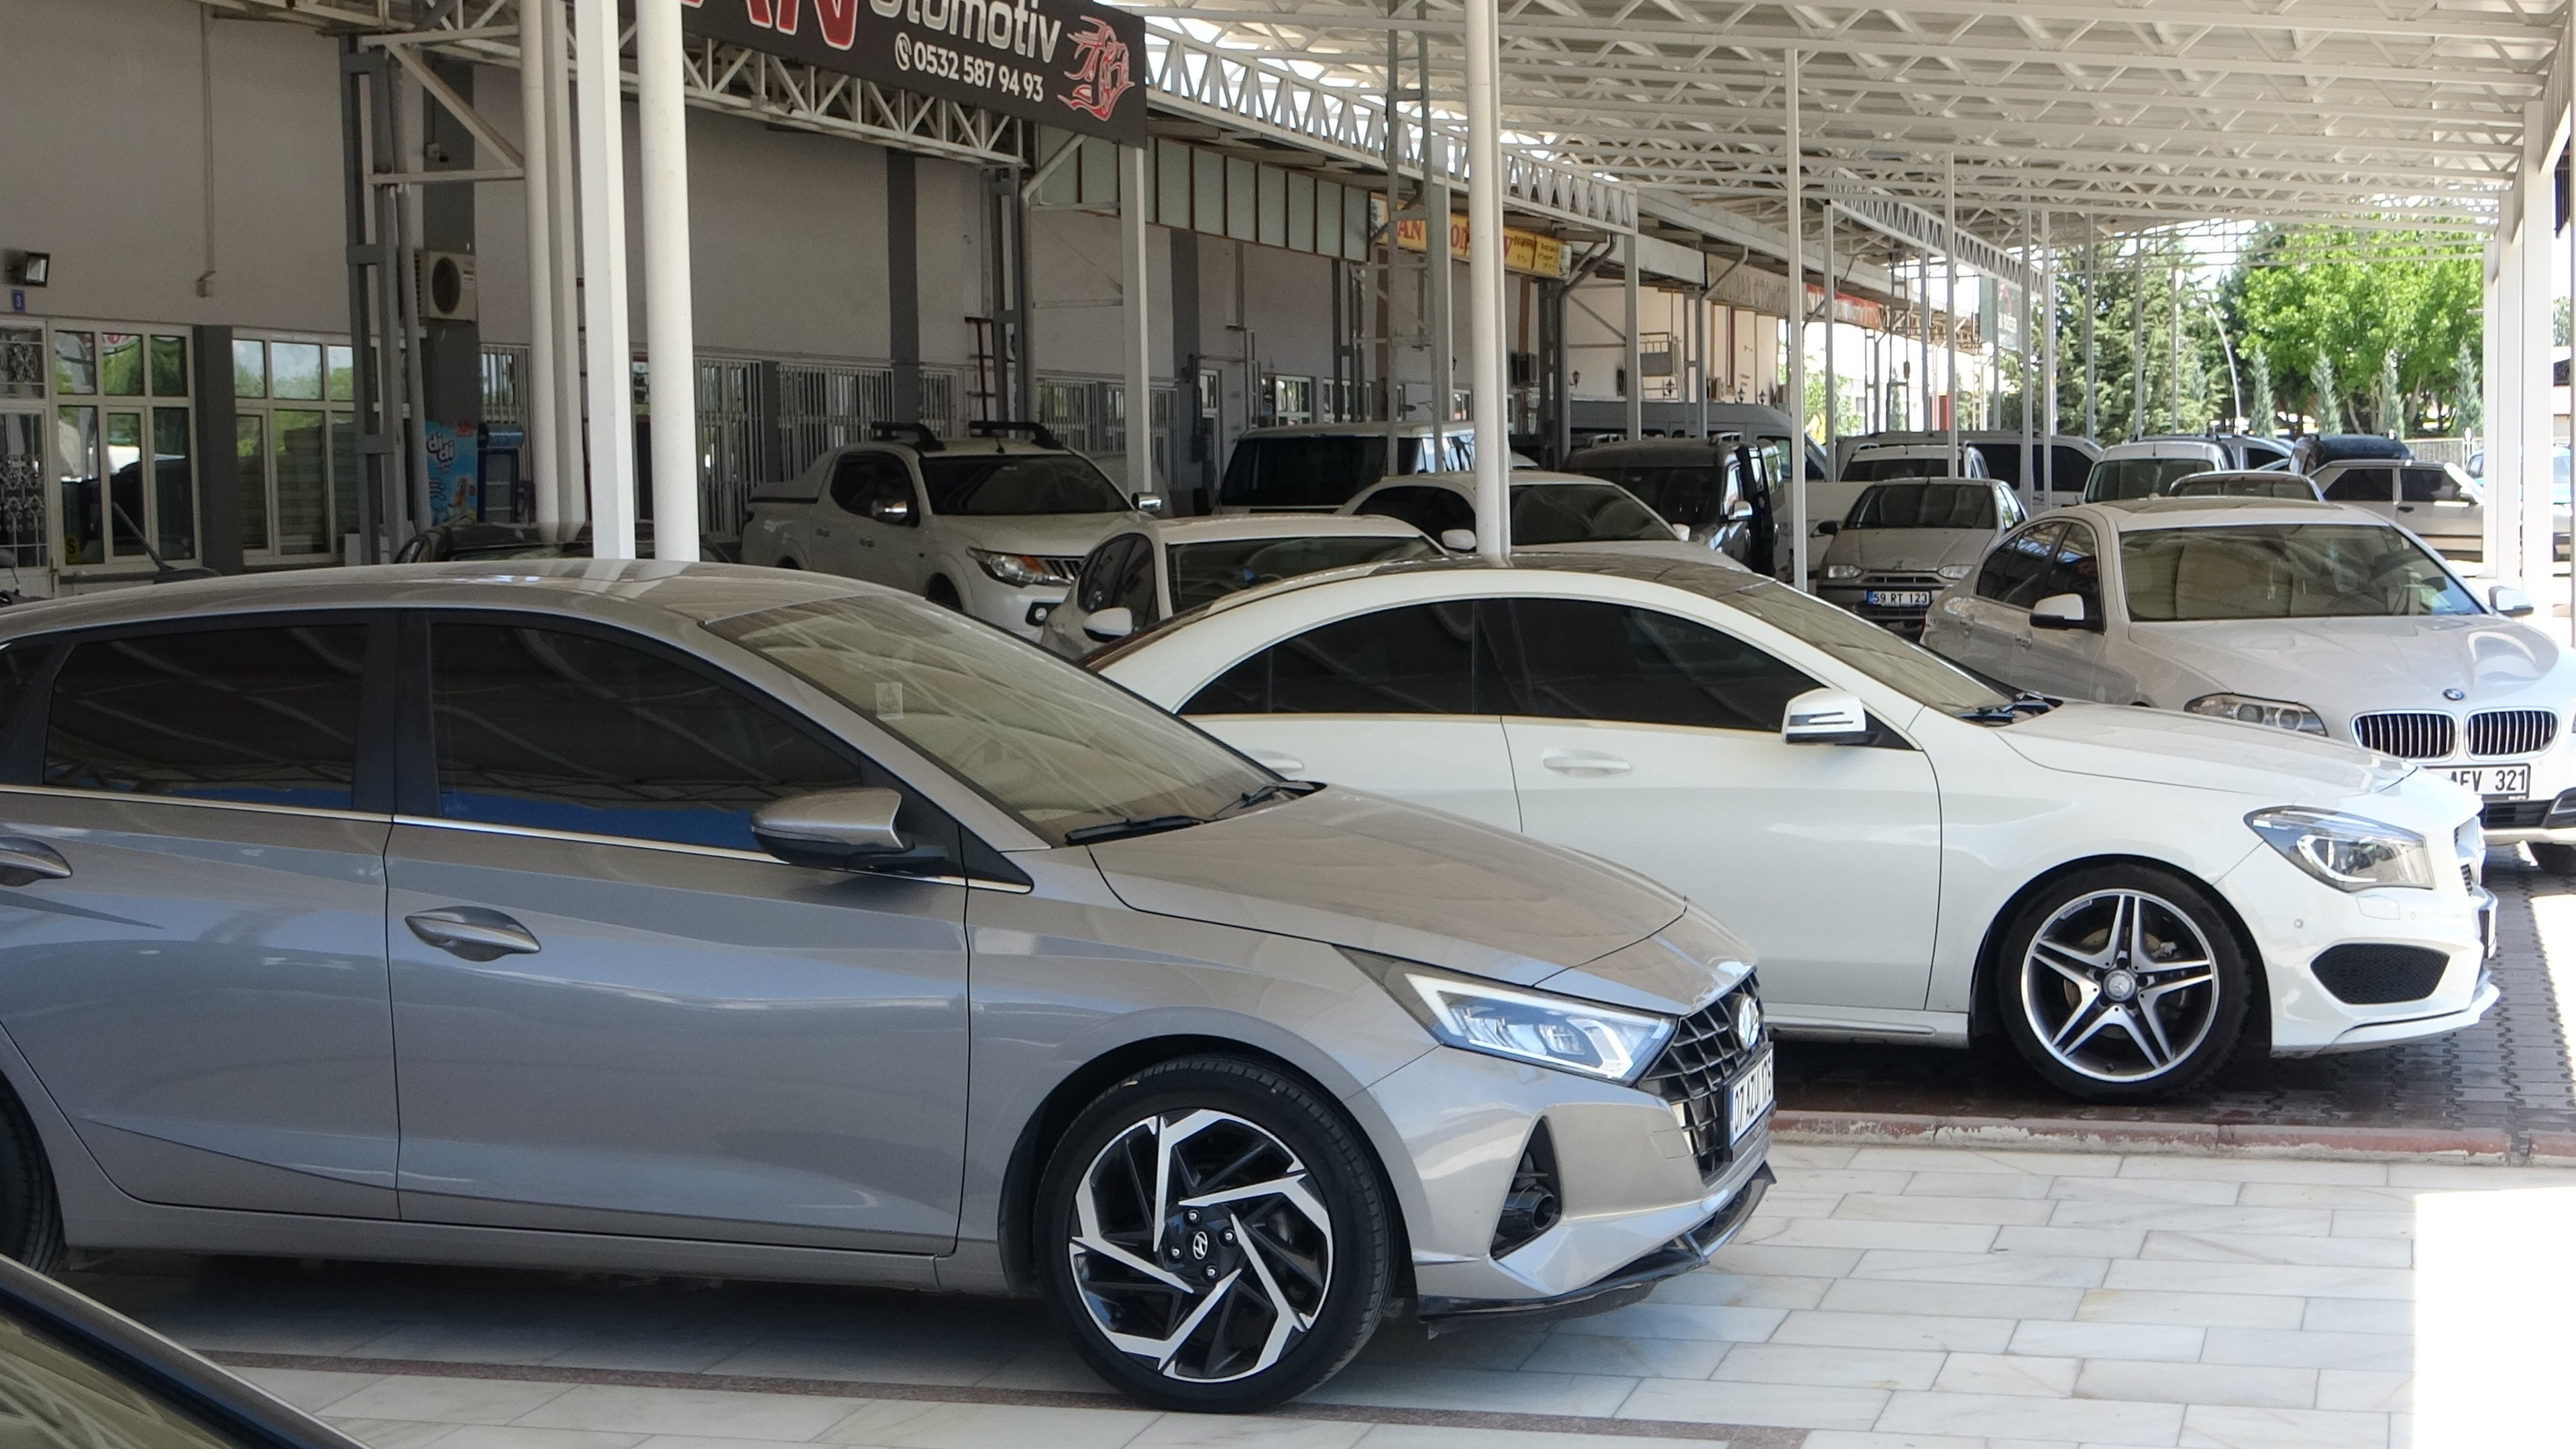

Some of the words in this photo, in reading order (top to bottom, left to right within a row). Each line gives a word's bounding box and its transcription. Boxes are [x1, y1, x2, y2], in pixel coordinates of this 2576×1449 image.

[914, 41, 959, 80] 0532
[963, 54, 996, 89] 587
[998, 65, 1020, 97] 94
[1022, 72, 1044, 102] 93
[1874, 593, 1886, 603] 59
[1890, 593, 1903, 603] RT
[1909, 593, 1927, 603] 123
[2495, 769, 2526, 792] 321
[1735, 1085, 1744, 1134] 07
